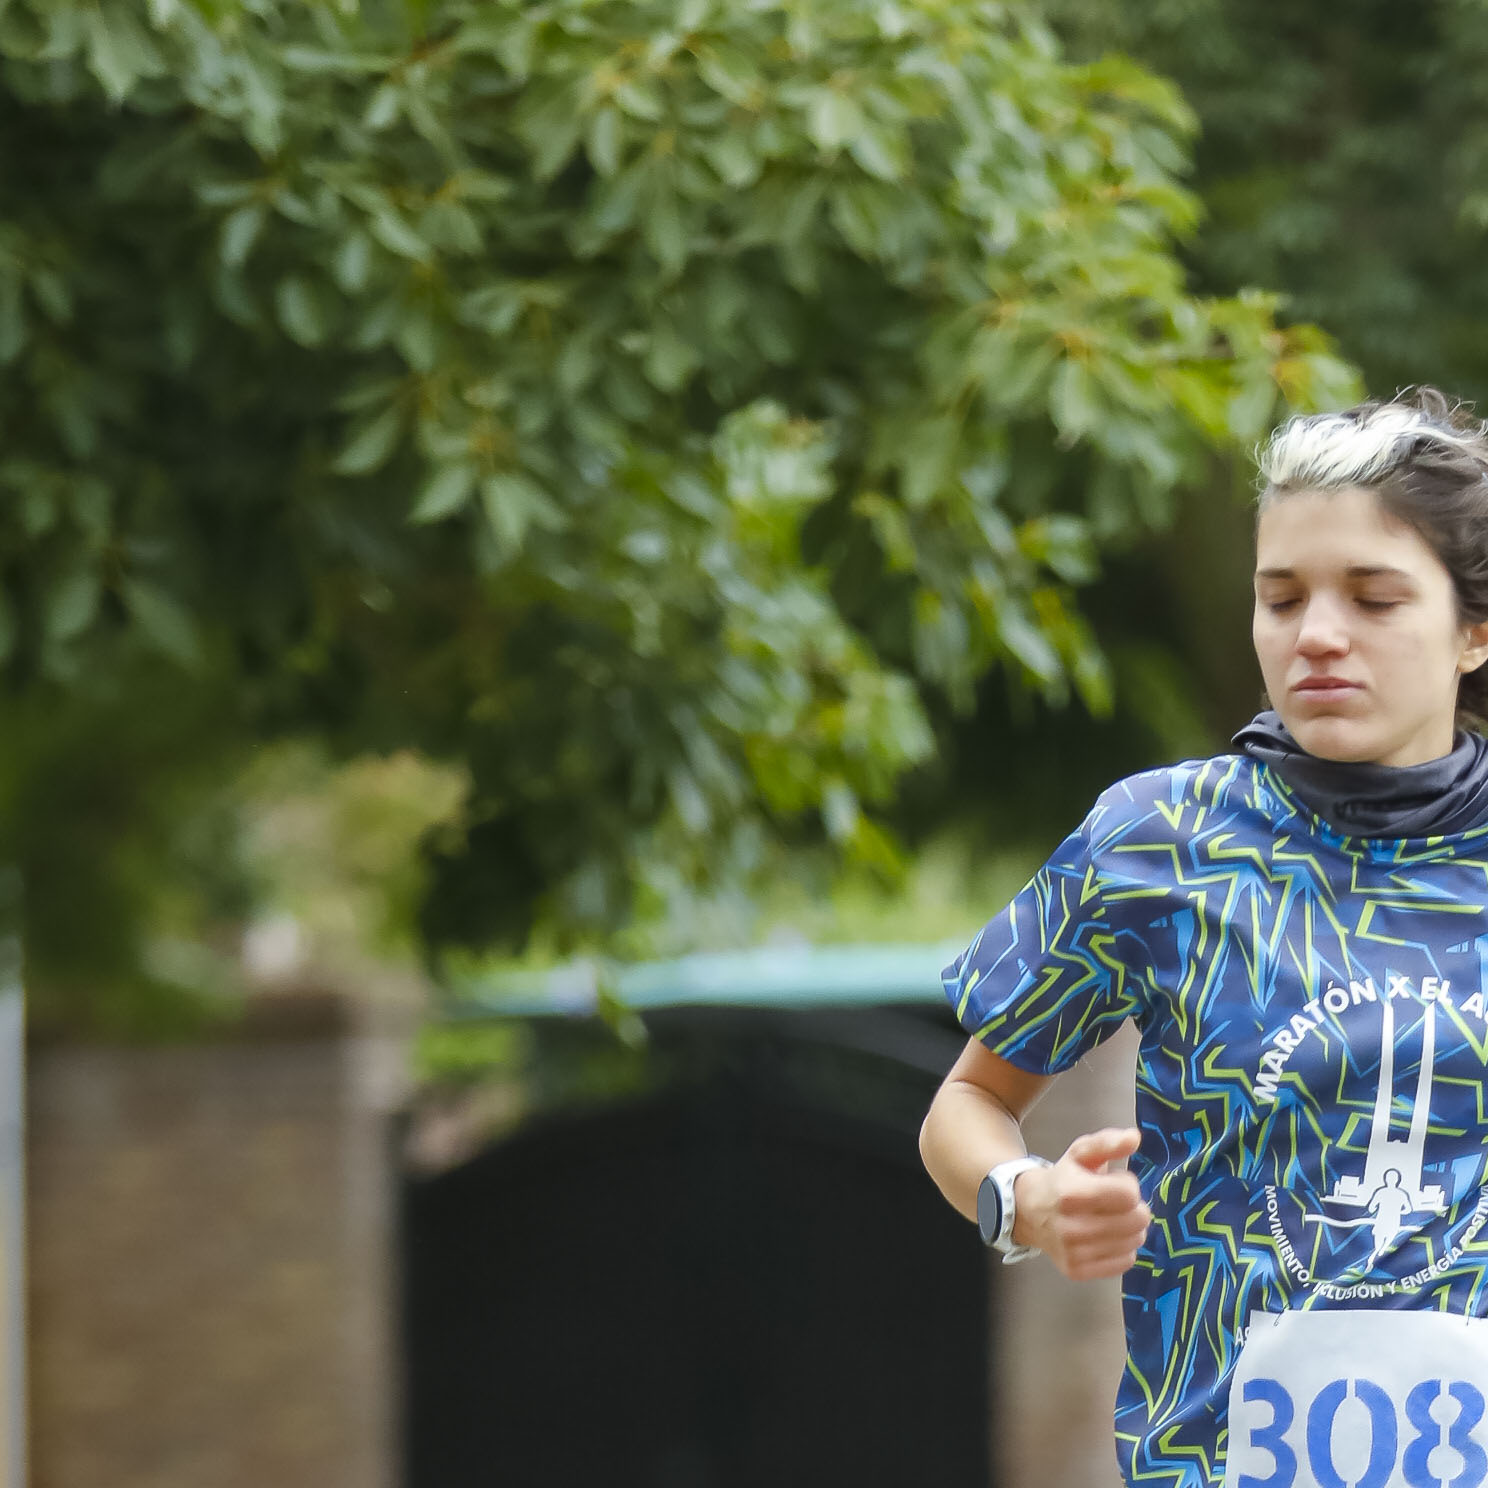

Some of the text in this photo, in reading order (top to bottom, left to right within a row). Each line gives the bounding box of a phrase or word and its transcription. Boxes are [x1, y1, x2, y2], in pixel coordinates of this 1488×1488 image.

[1253, 977, 1377, 1102] MARATÓN
[1388, 976, 1411, 999] X
[1421, 976, 1453, 1006] EL
[1265, 1185, 1311, 1288] MOVIMIENTO,
[1313, 1281, 1384, 1301] ICLUSIÓN
[1386, 1281, 1397, 1294] Y
[1401, 1247, 1464, 1290] ENERGÍA
